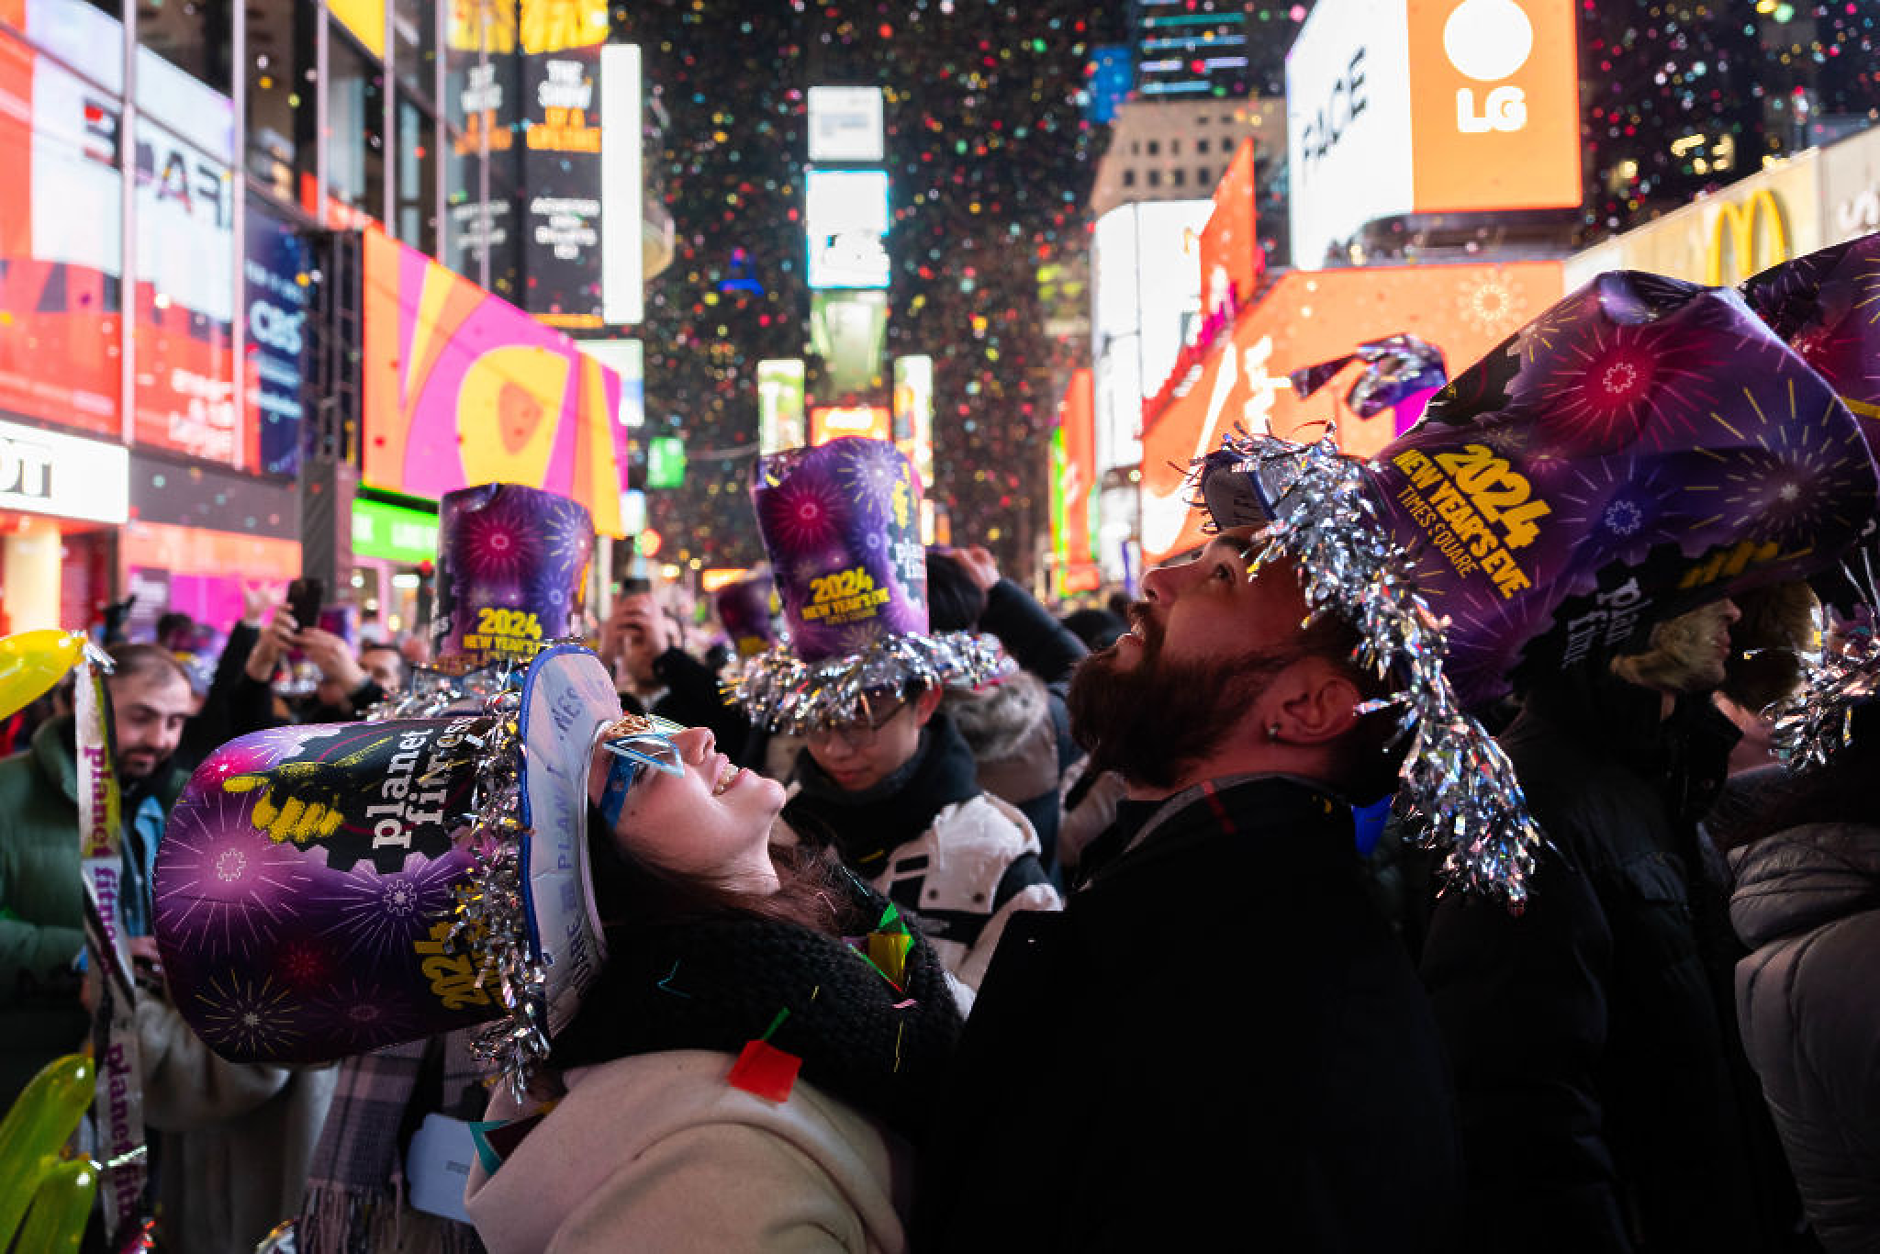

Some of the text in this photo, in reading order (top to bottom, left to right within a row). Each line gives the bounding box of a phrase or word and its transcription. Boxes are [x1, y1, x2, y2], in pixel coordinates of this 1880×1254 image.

[1456, 86, 1529, 133] LG
[1393, 449, 1532, 599] NEW YEAR'S EVE
[1397, 485, 1479, 579] TIMES SQUARE
[1434, 444, 1551, 549] 2024
[477, 607, 543, 640] 2024
[802, 602, 830, 620] NEW
[809, 566, 875, 603] 2024
[463, 634, 493, 649] NEW
[84, 746, 113, 857] planet
[366, 728, 434, 849] planet
[414, 920, 491, 1010] 2024
[104, 1043, 134, 1156] planet
